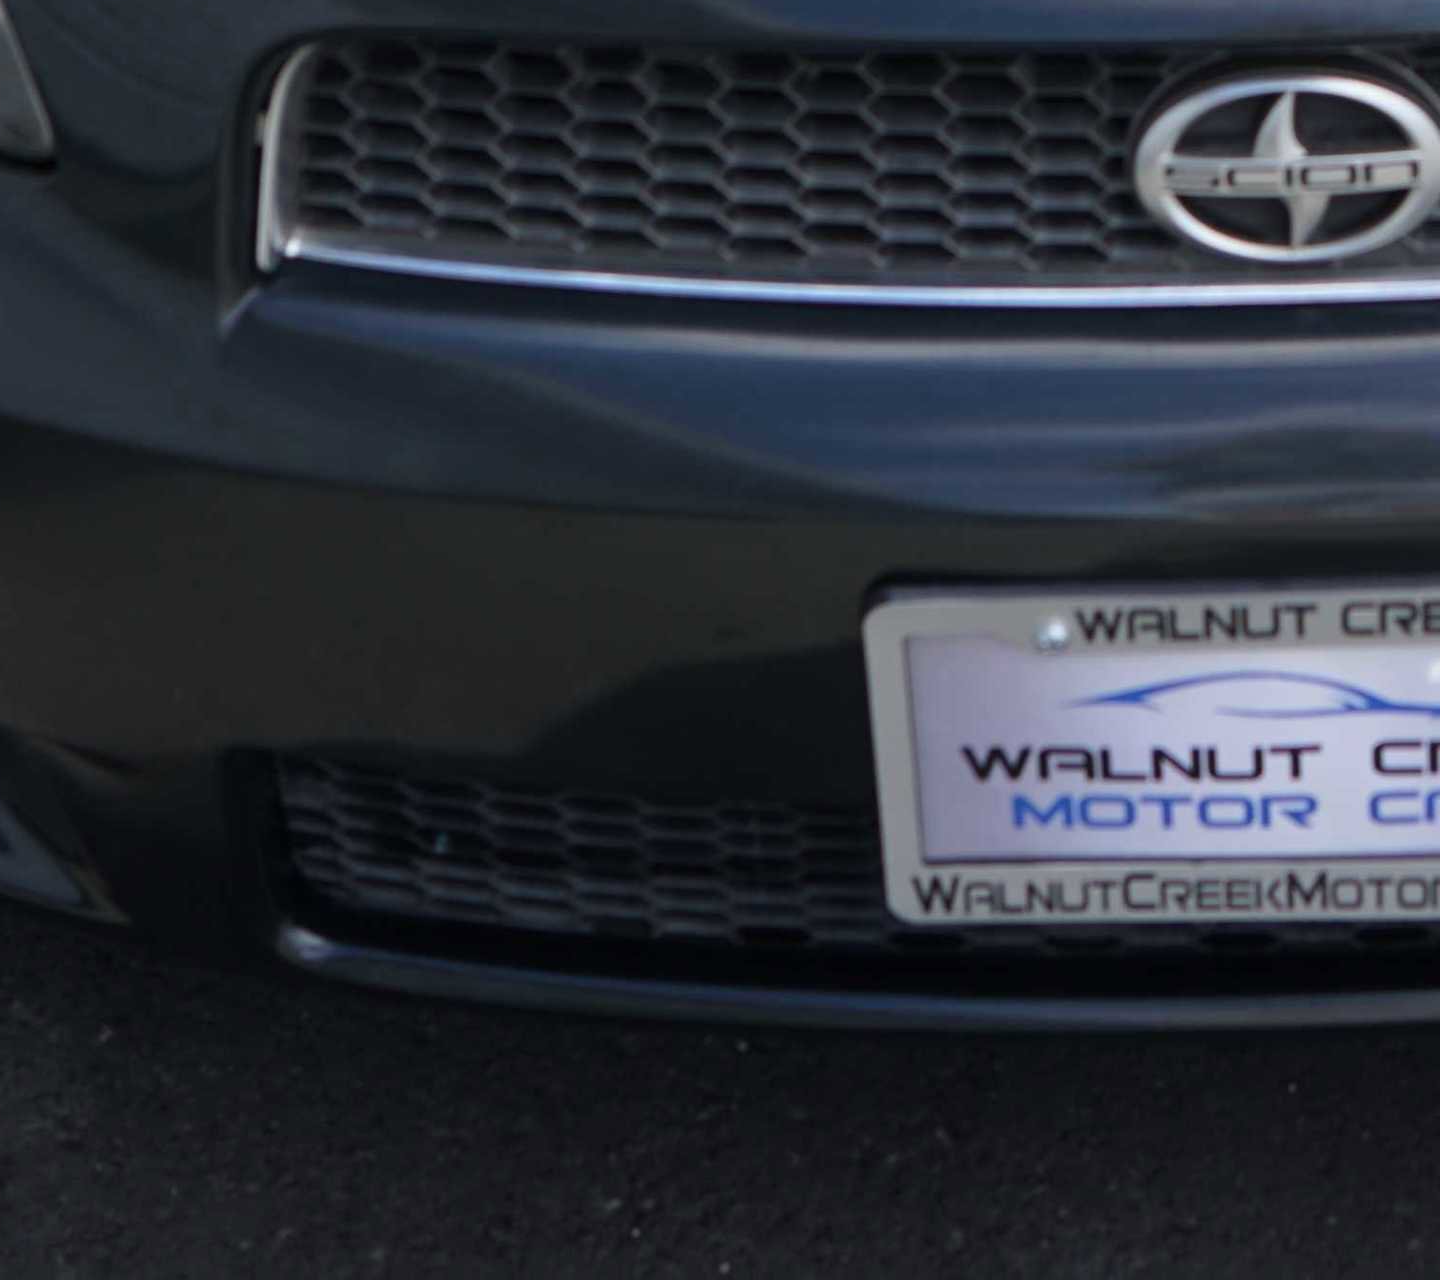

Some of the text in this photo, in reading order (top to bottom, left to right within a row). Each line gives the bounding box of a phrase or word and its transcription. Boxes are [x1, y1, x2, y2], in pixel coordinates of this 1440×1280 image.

[1074, 603, 1318, 642] WALNUT
[962, 744, 1322, 782] WALNUT
[1011, 792, 1319, 830] MOTOR
